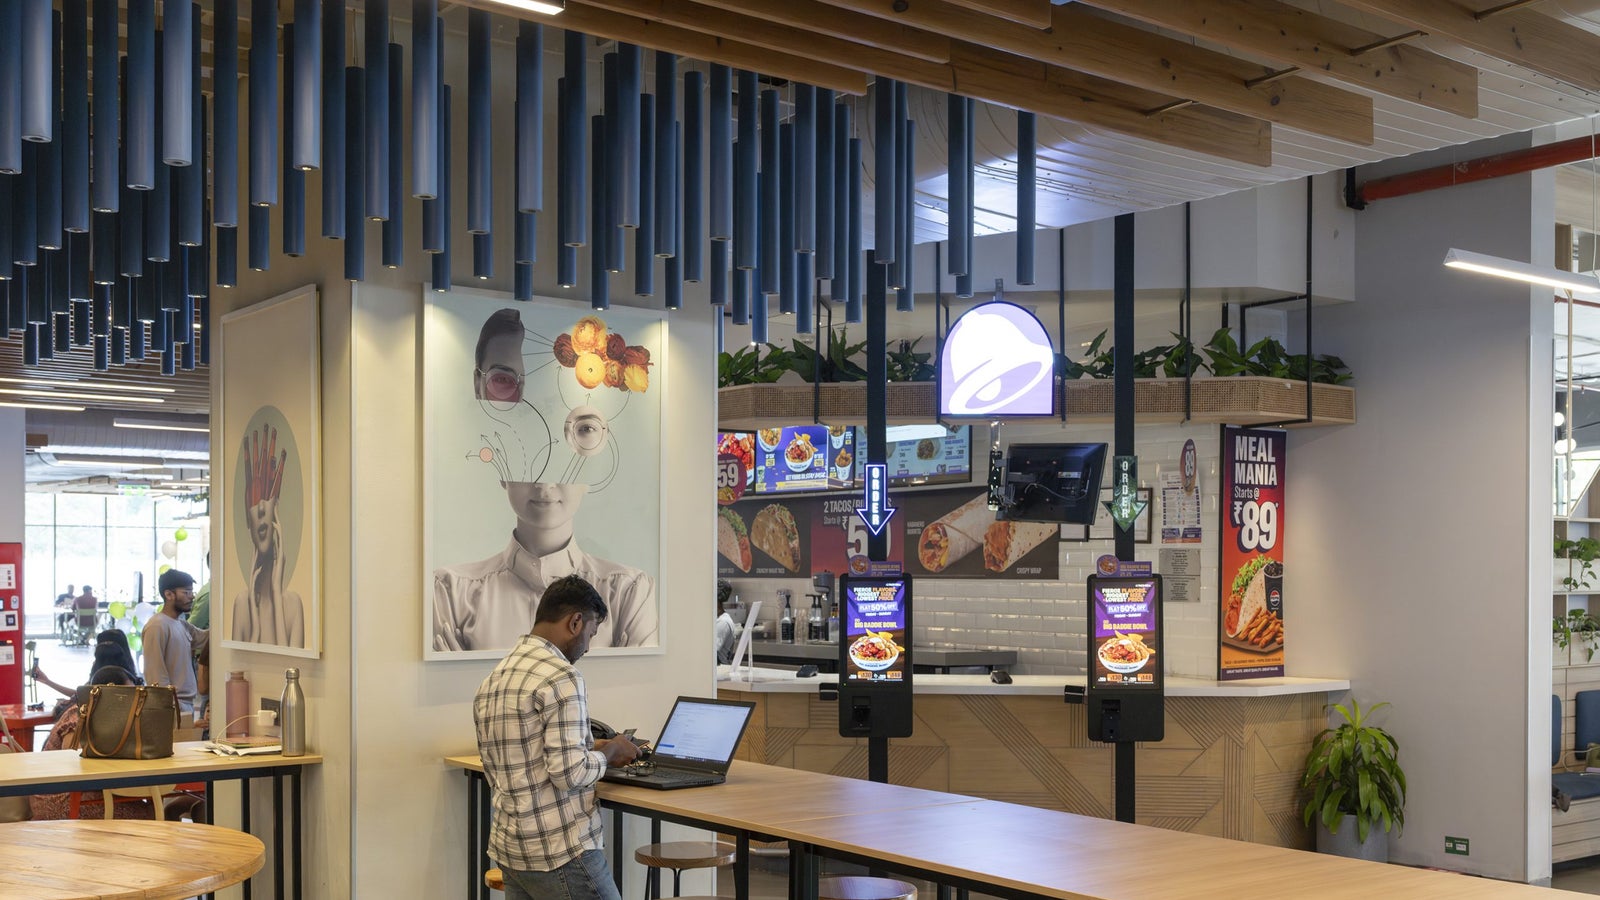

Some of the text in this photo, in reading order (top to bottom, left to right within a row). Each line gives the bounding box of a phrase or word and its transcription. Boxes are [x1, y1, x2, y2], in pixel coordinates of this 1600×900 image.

[1235, 435, 1276, 463] MEAL
[1234, 462, 1278, 486] MANIA
[871, 466, 880, 526] ORDER
[1121, 460, 1129, 519] ORDER
[1234, 485, 1260, 500] Starts @
[823, 500, 829, 513] 2
[870, 602, 888, 611] 50%
[1120, 604, 1137, 612] 50%
